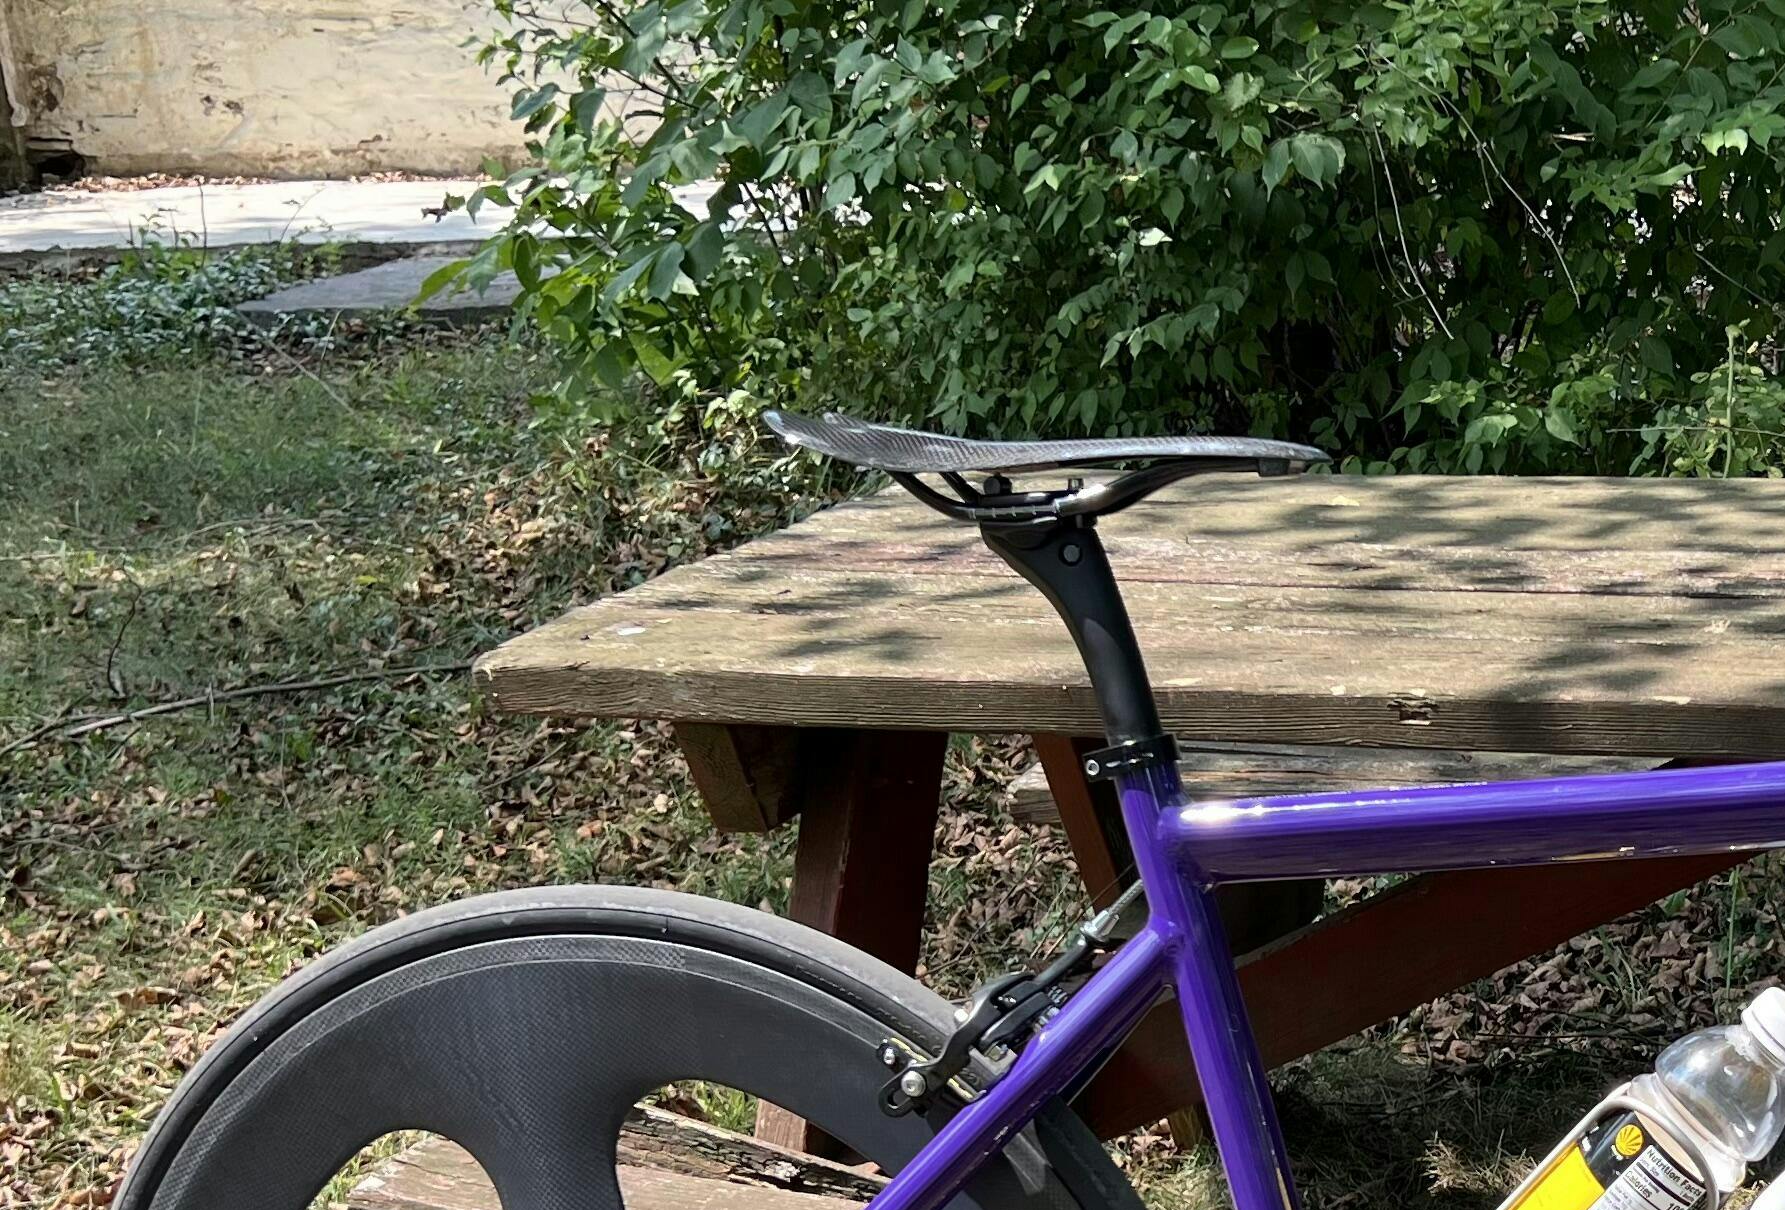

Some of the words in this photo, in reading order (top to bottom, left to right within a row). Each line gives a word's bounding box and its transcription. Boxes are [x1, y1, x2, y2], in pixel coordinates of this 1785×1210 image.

[1625, 1170, 1653, 1199] Calories
[1646, 1148, 1681, 1184] Nutrition
[1679, 1177, 1702, 1197] Facts
